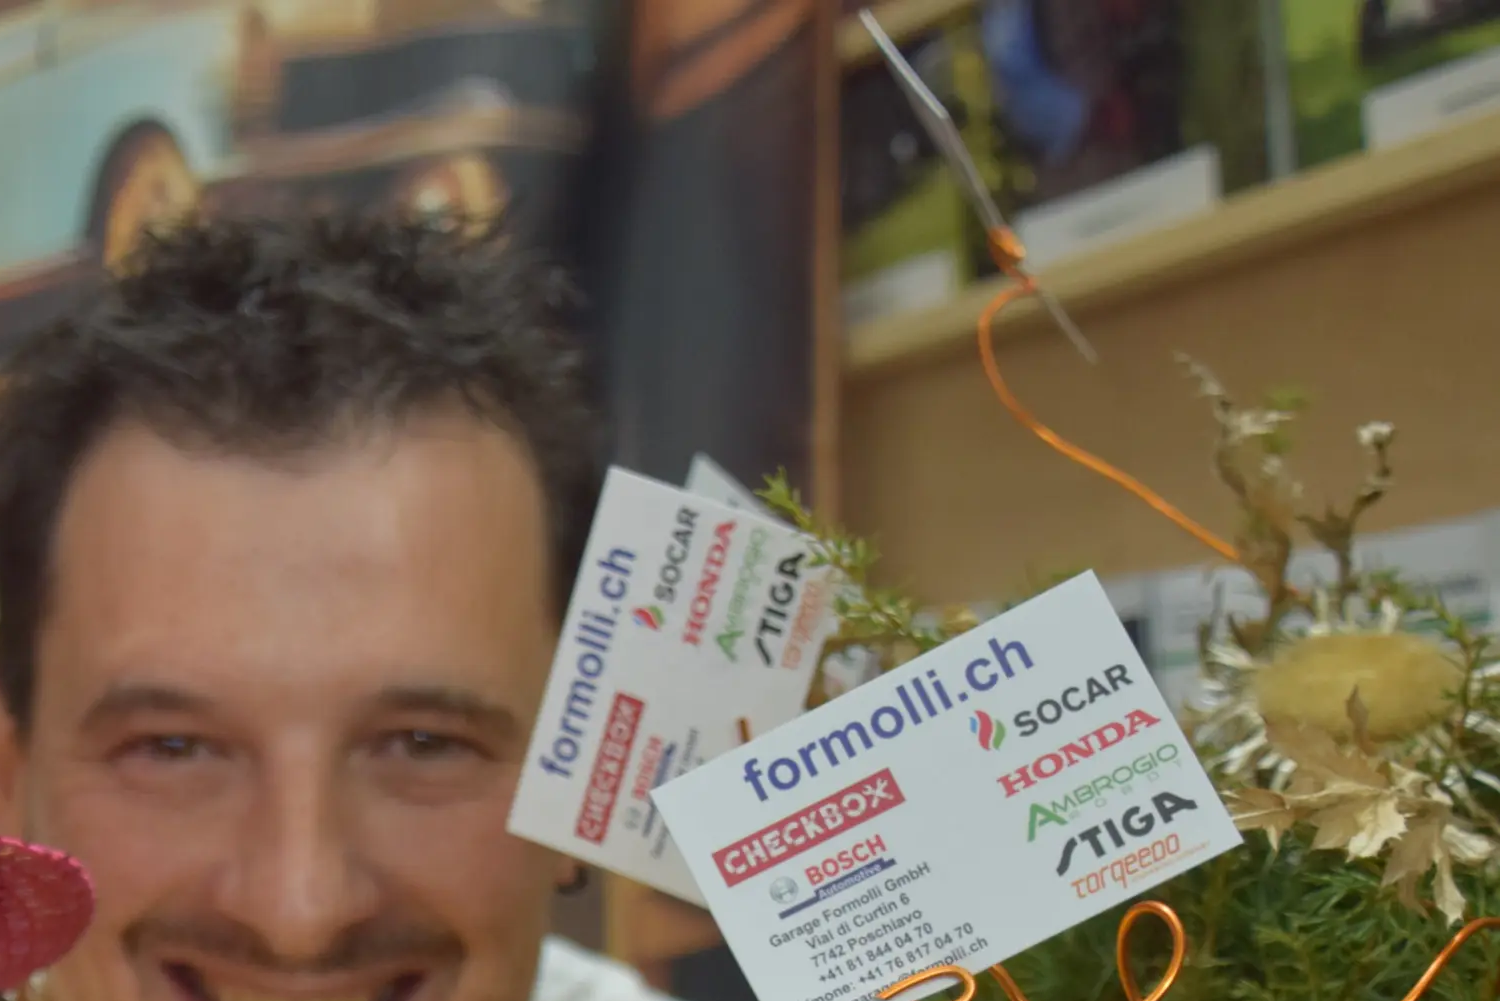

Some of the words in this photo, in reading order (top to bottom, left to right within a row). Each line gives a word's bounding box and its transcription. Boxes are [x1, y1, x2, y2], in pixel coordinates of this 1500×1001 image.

[654, 506, 700, 603] SOCAR
[682, 520, 737, 646] HONDA
[539, 548, 636, 778] formolli.ch
[1013, 663, 1133, 738] SOCAR
[743, 637, 1035, 802] formolli.ch
[997, 709, 1161, 798] HONDA
[723, 777, 894, 875] CHECKBOX
[805, 833, 888, 886] BOSCH
[769, 917, 821, 947] Garage
[822, 885, 883, 922] Formolli
[884, 861, 931, 892] GmbH
[805, 929, 834, 949] Vial
[837, 920, 852, 936] di
[853, 898, 898, 928] Curtin
[900, 892, 911, 905] 6
[818, 863, 881, 899] Automotive
[810, 944, 846, 968] 7742
[846, 909, 922, 952] Poschiavo
[819, 965, 843, 983] +41
[846, 952, 864, 971] 81
[866, 941, 893, 963] 844
[895, 932, 913, 949] 04
[914, 922, 933, 939] 70
[859, 966, 883, 984] +41
[885, 956, 904, 974] 76
[907, 942, 931, 963] 817
[934, 932, 953, 950] 04
[954, 922, 973, 939] 70
